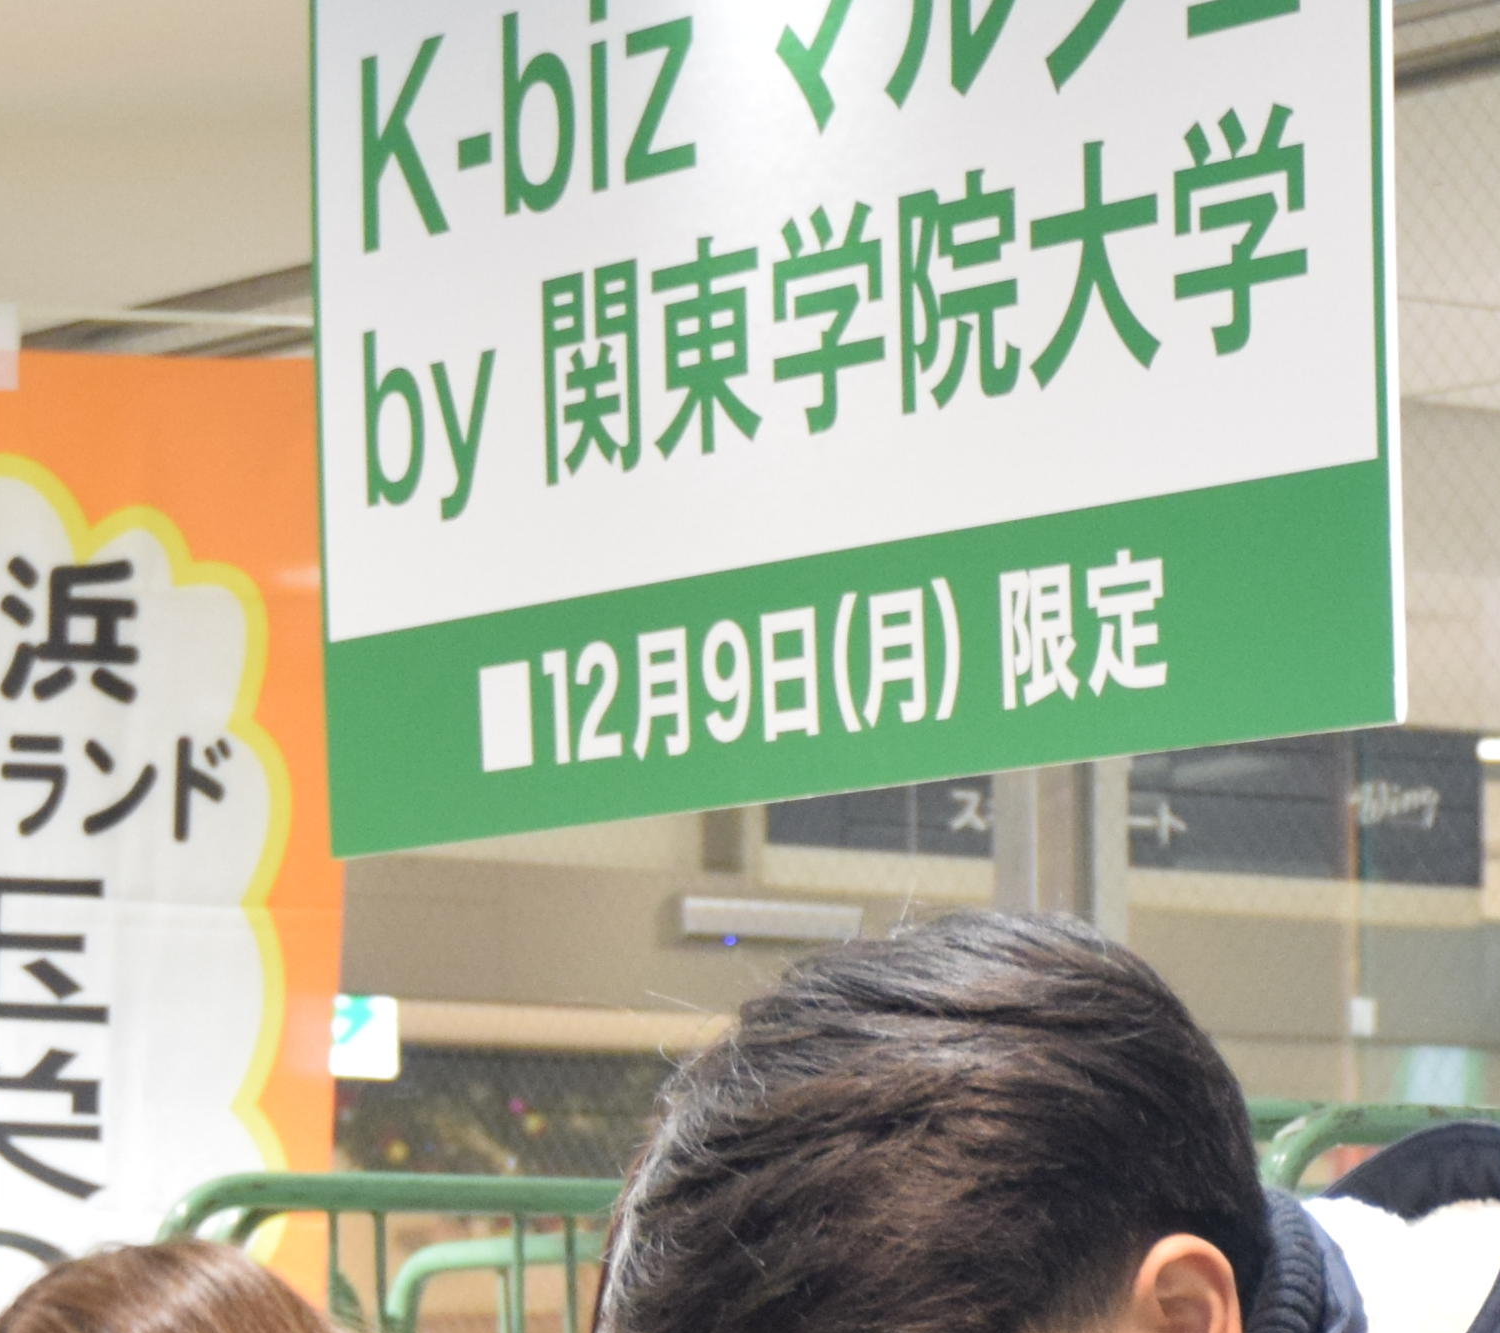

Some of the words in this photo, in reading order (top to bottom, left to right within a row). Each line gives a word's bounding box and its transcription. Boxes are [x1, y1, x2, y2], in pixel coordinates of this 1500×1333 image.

[362, 0, 697, 254] K-biz
[361, 329, 497, 521] by
[540, 102, 1309, 488] 関東学院大学
[996, 548, 1169, 711] 限定
